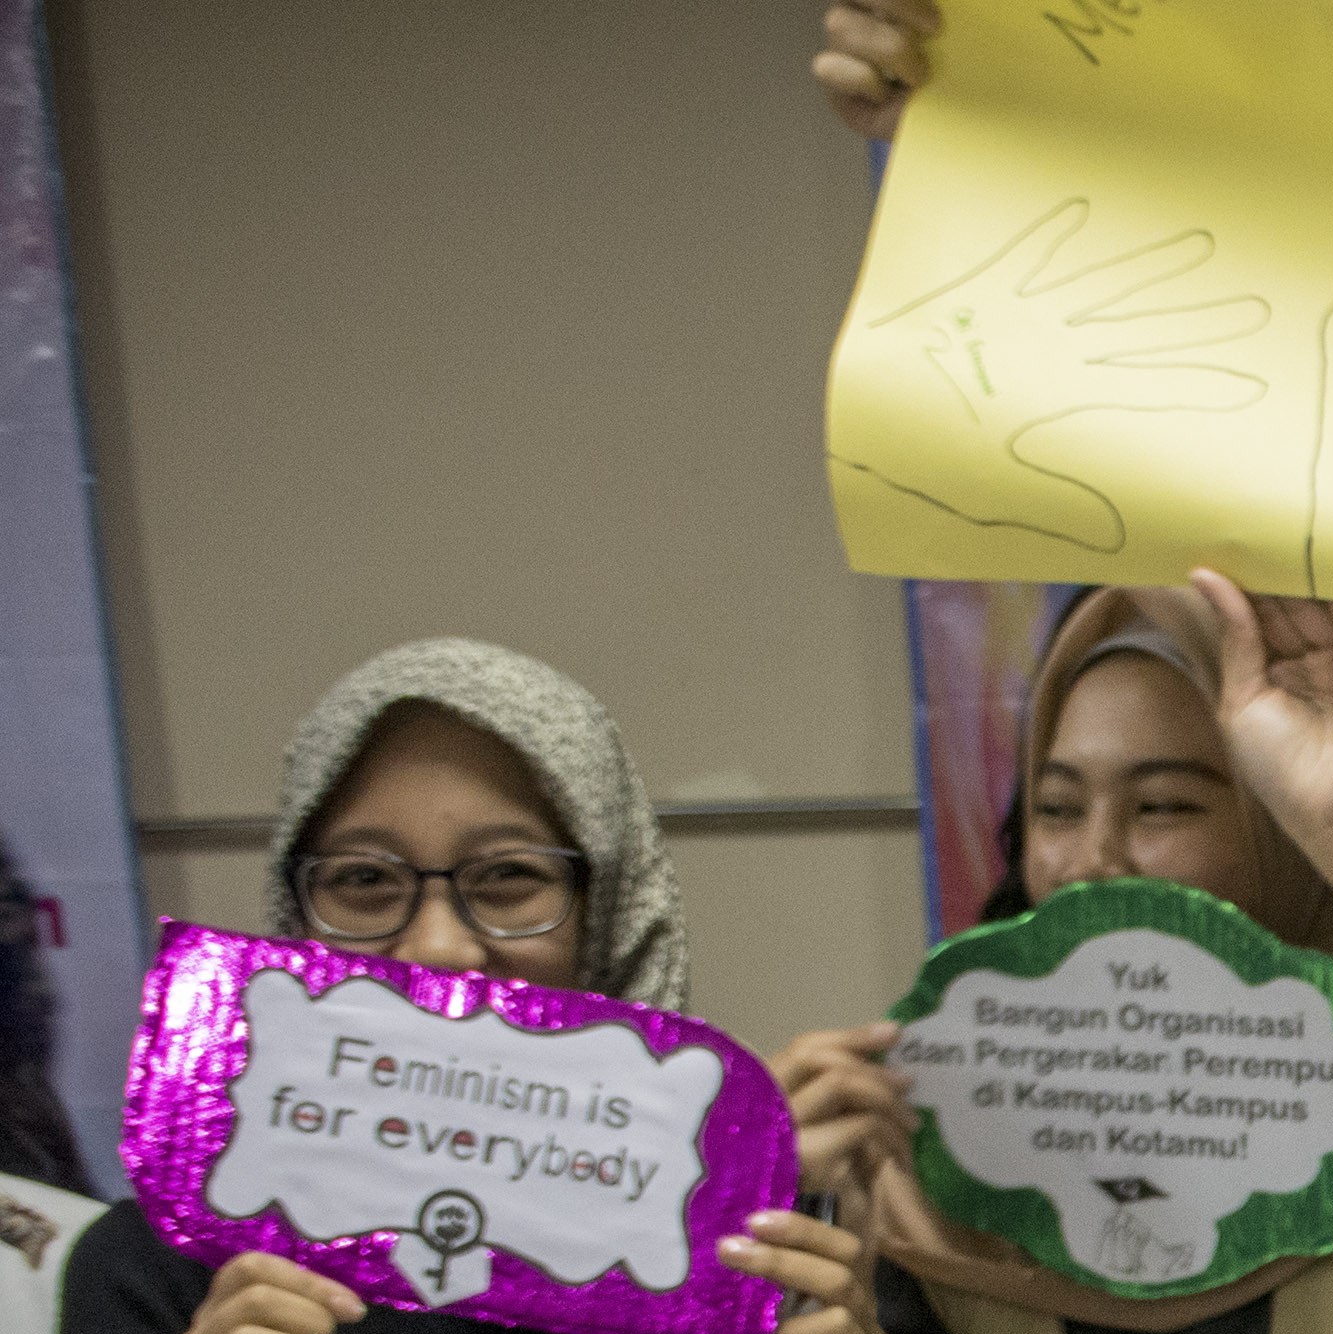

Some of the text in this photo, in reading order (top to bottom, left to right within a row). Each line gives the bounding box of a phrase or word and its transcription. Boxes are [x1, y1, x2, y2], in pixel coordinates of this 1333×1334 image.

[1107, 962, 1169, 992] Yuk
[974, 998, 1306, 1040] Bangun Organisasi
[902, 1039, 965, 1066] dan
[328, 1035, 634, 1130] Feminism is
[972, 1078, 1309, 1124] di Kampus-Kampus
[1033, 1125, 1248, 1160] dan Kotamu!
